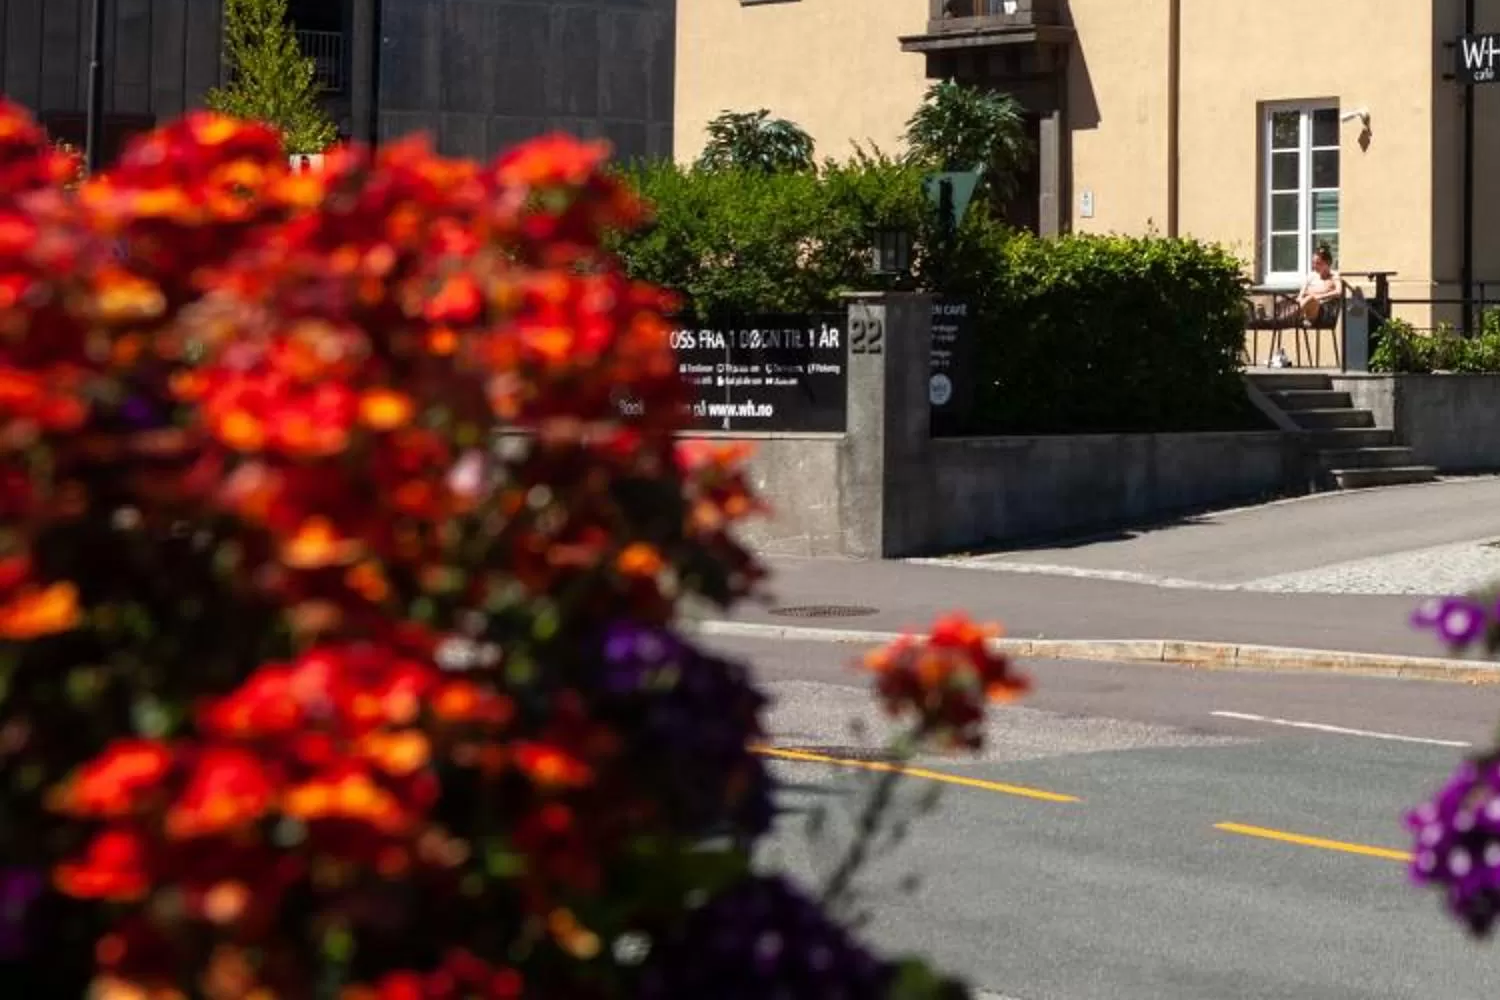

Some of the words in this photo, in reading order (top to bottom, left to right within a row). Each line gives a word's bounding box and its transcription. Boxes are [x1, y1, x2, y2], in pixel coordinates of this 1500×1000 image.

[669, 329, 696, 349] OSS
[699, 330, 726, 349] FRA
[851, 319, 883, 355] 22
[708, 400, 773, 417] www.wh.no
